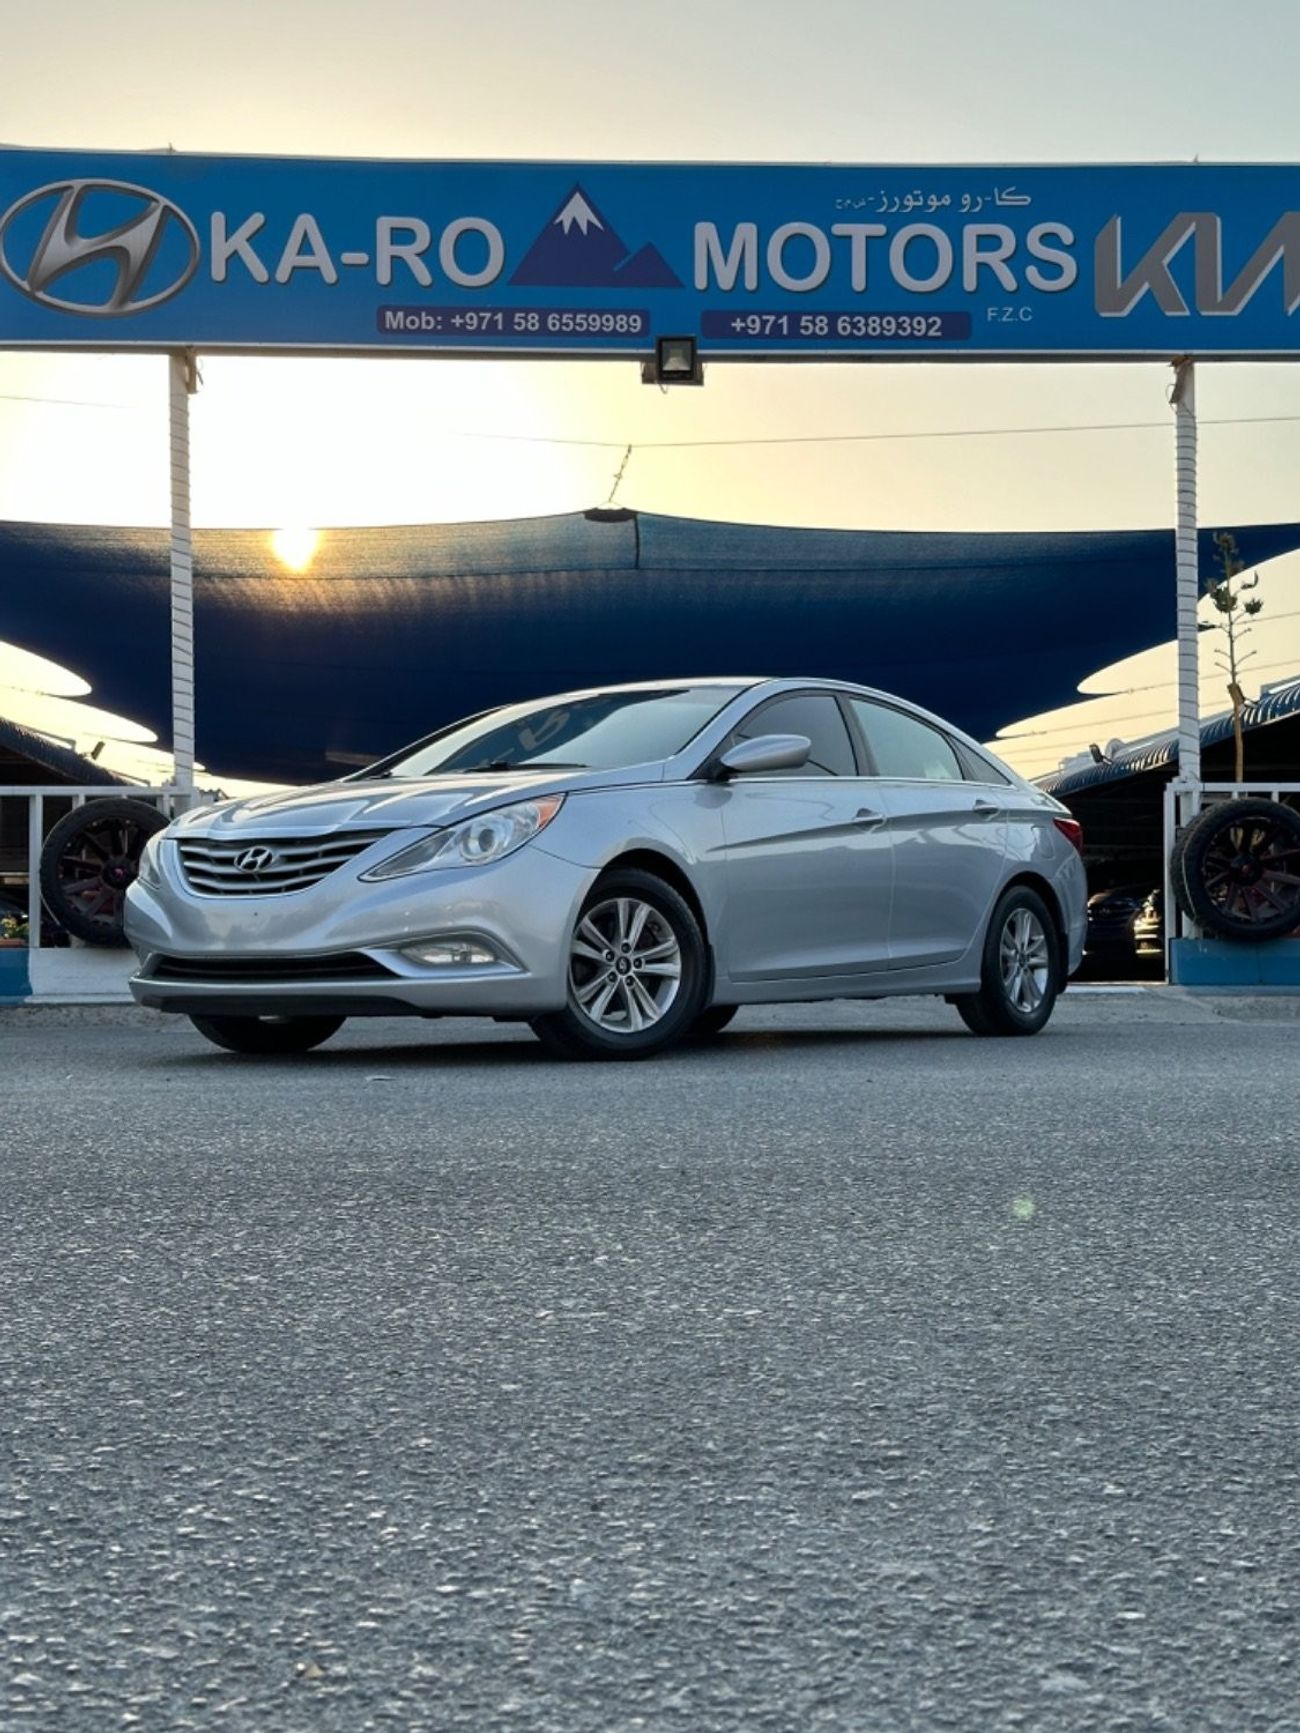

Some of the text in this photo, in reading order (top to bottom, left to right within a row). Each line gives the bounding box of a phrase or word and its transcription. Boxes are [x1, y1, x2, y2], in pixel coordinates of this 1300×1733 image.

[209, 211, 505, 288] KA-RO
[693, 221, 1078, 293] MOTORS
[384, 310, 643, 333] Mob: +971 58 6559989
[731, 315, 942, 338] +971 58 6389392
